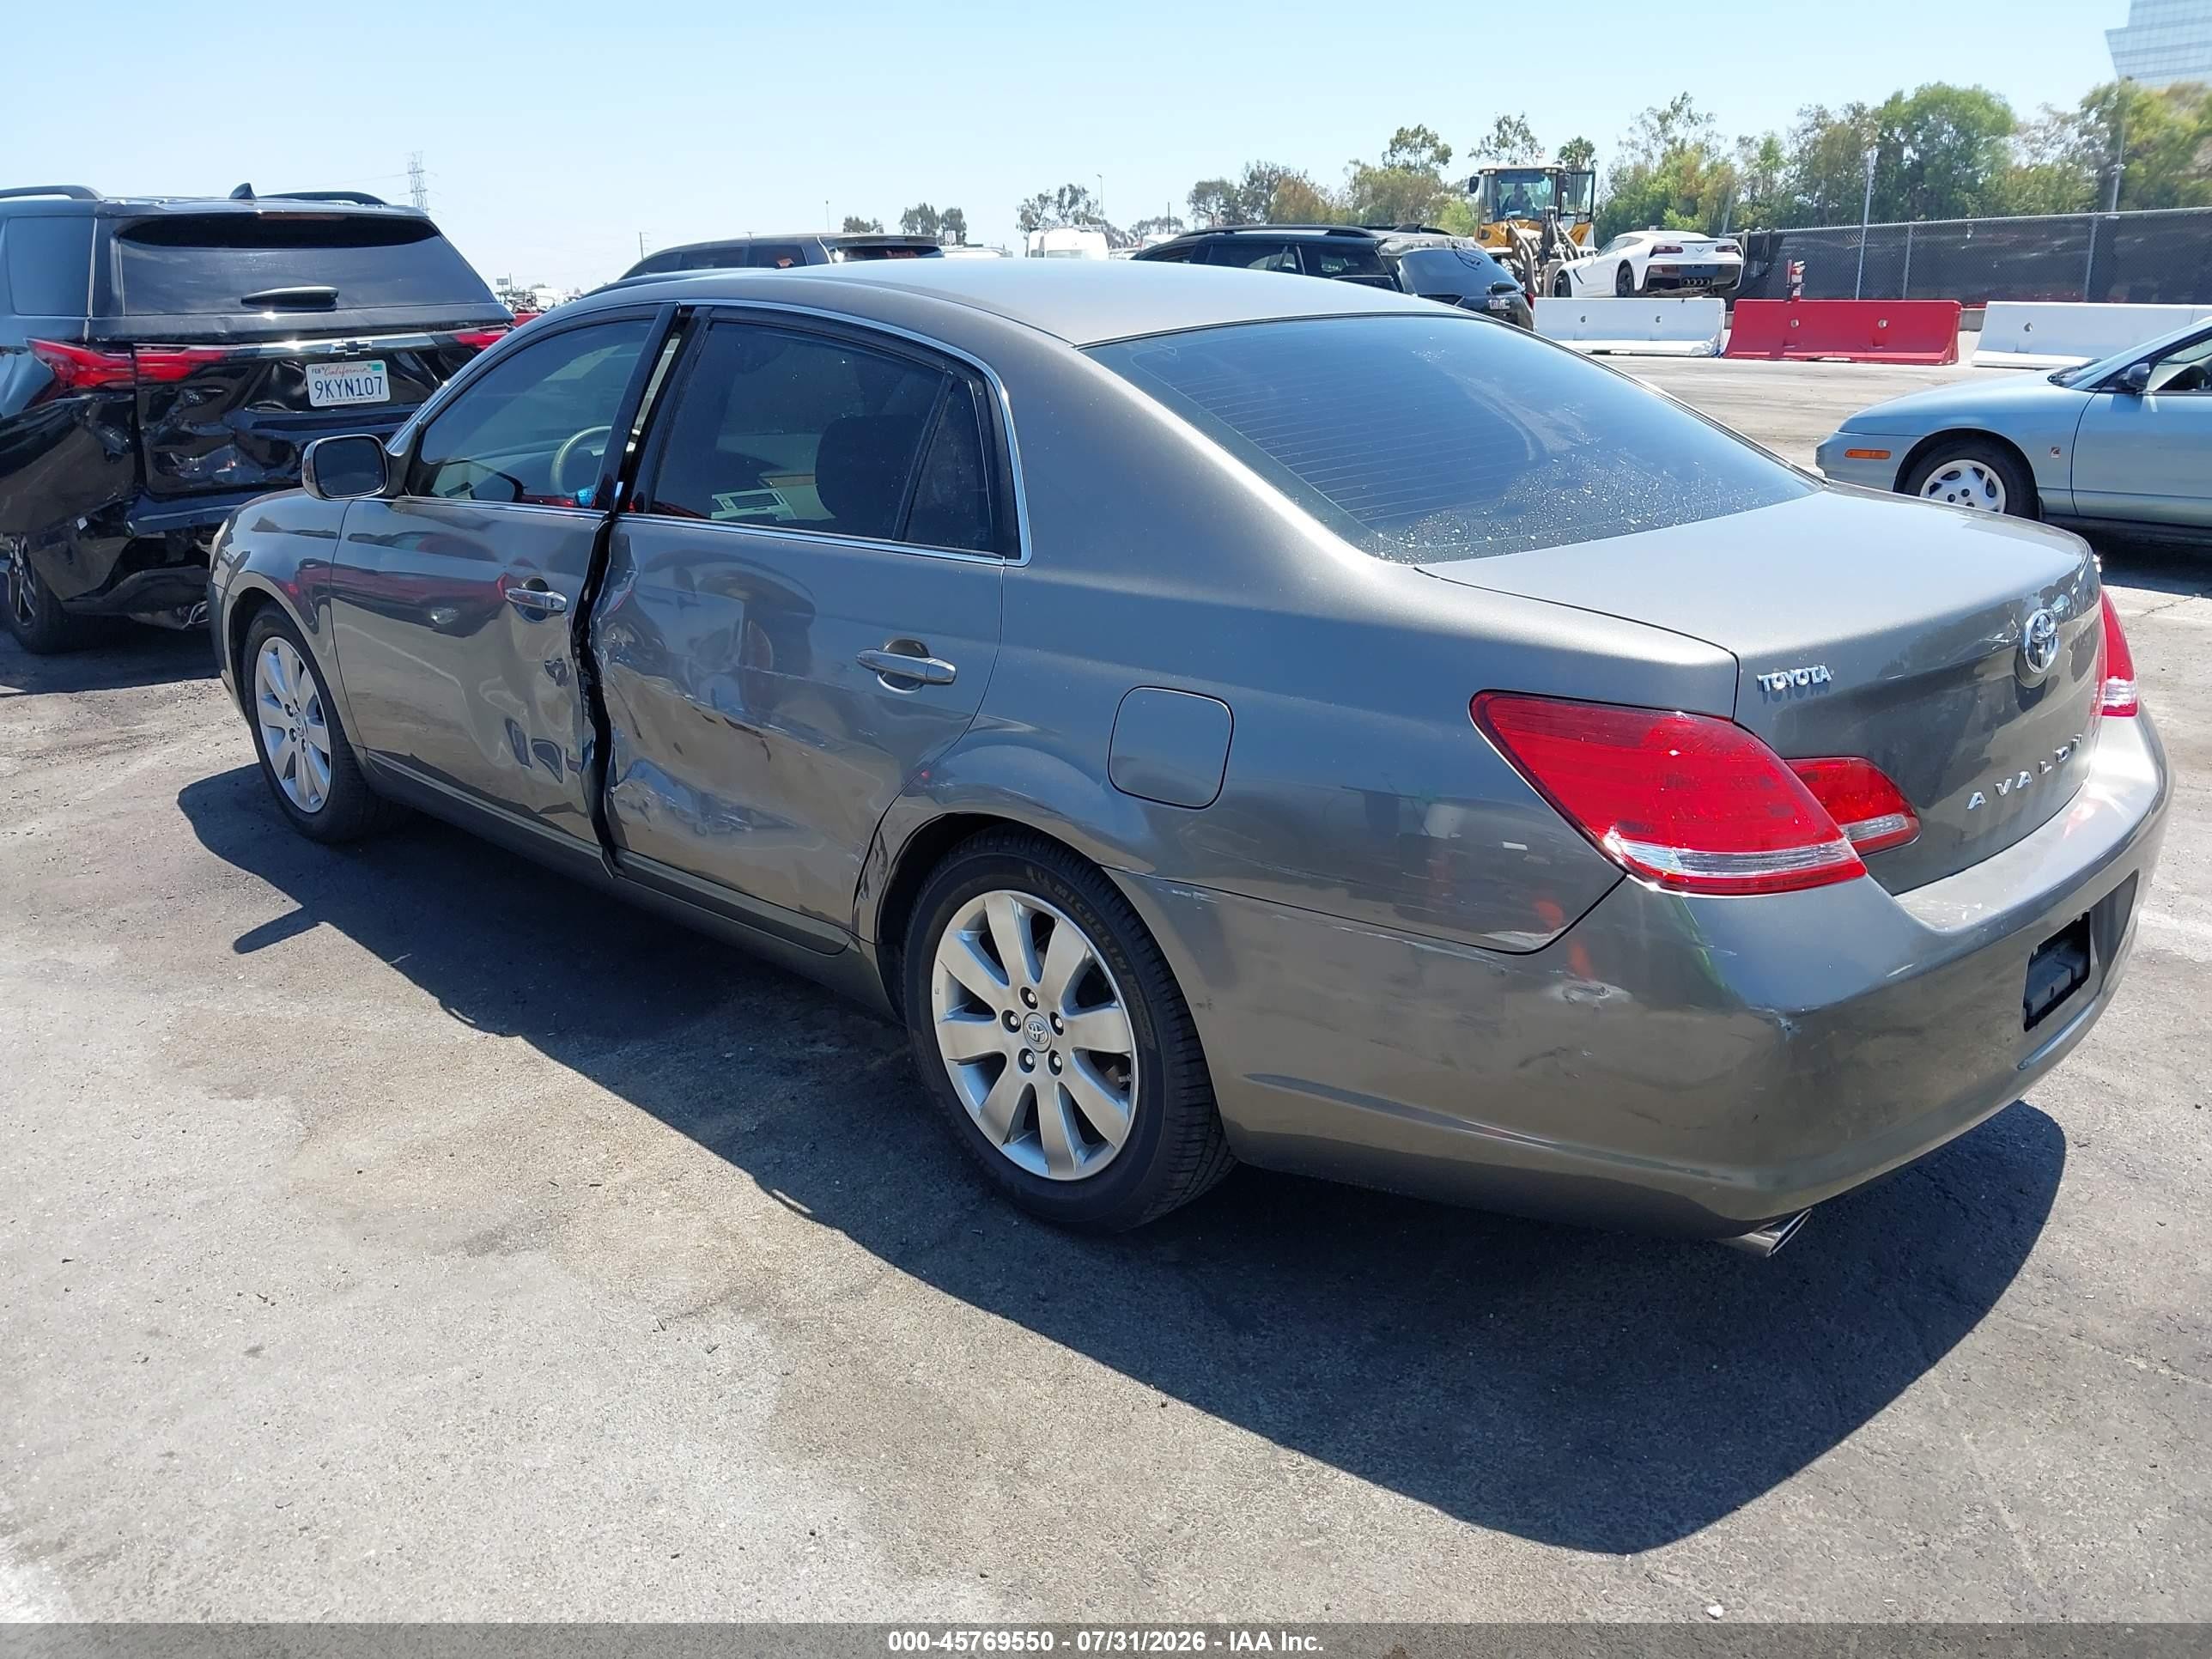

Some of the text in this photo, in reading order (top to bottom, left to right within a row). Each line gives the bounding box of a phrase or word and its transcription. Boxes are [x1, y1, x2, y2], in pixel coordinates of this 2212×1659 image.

[314, 376, 382, 400] 9KYN107
[1757, 665, 1832, 692] TOYOTA
[1054, 884, 1128, 970] MICHELIN
